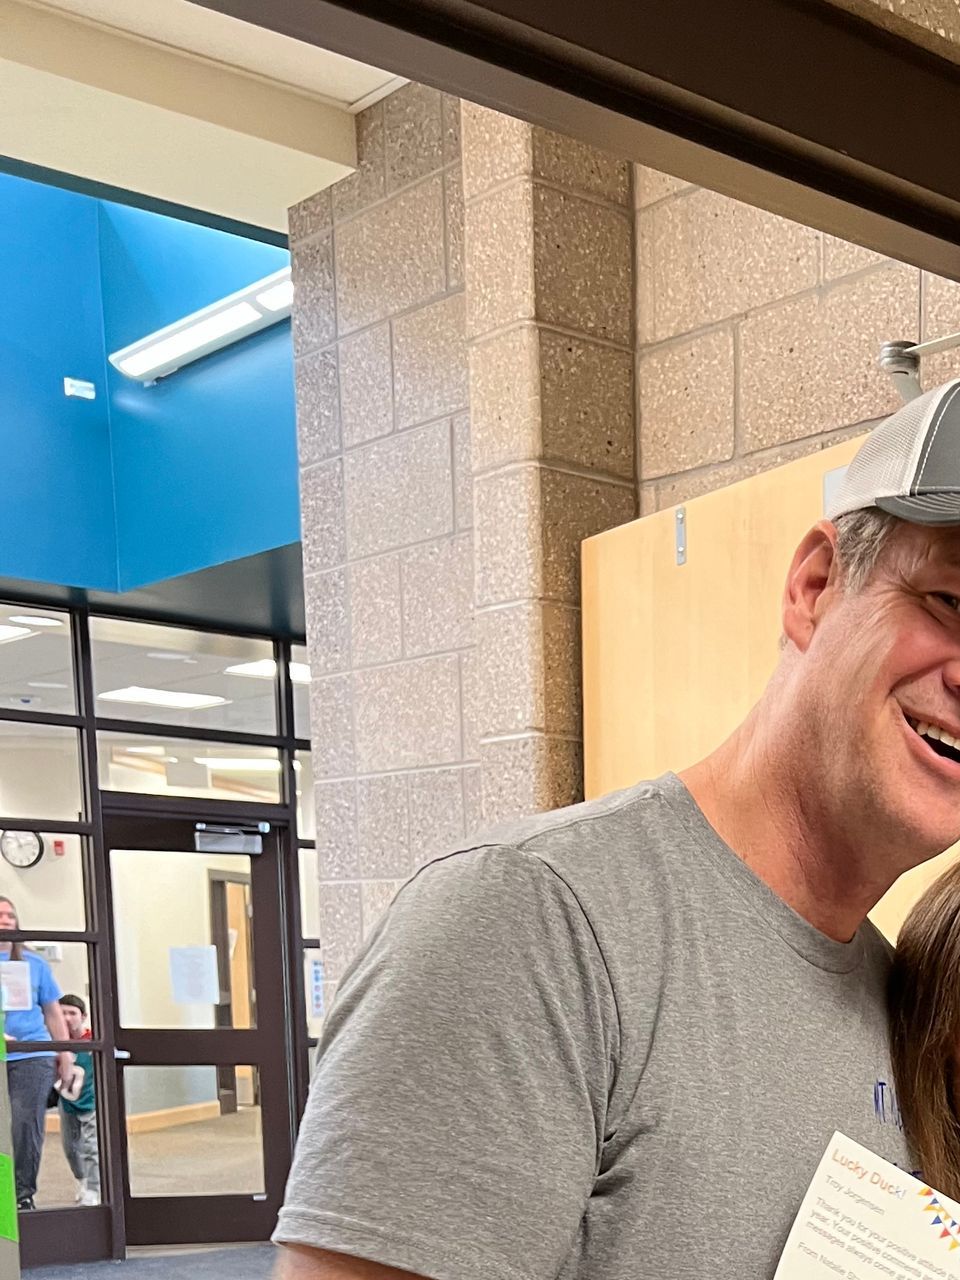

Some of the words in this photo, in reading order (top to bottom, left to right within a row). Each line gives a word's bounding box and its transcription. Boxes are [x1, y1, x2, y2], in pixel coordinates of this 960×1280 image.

[823, 1174, 846, 1192] Troy
[832, 1147, 869, 1180] Lucky
[869, 1171, 907, 1200] Duck!
[797, 1241, 819, 1259] From
[816, 1196, 841, 1217] Thank
[840, 1213, 857, 1226] you
[856, 1221, 870, 1233] for
[867, 1229, 888, 1243] your
[885, 1240, 918, 1261] positive
[917, 1257, 948, 1277] attitude
[833, 1219, 853, 1237] Your
[850, 1233, 882, 1255] positive
[873, 1260, 897, 1277] come
